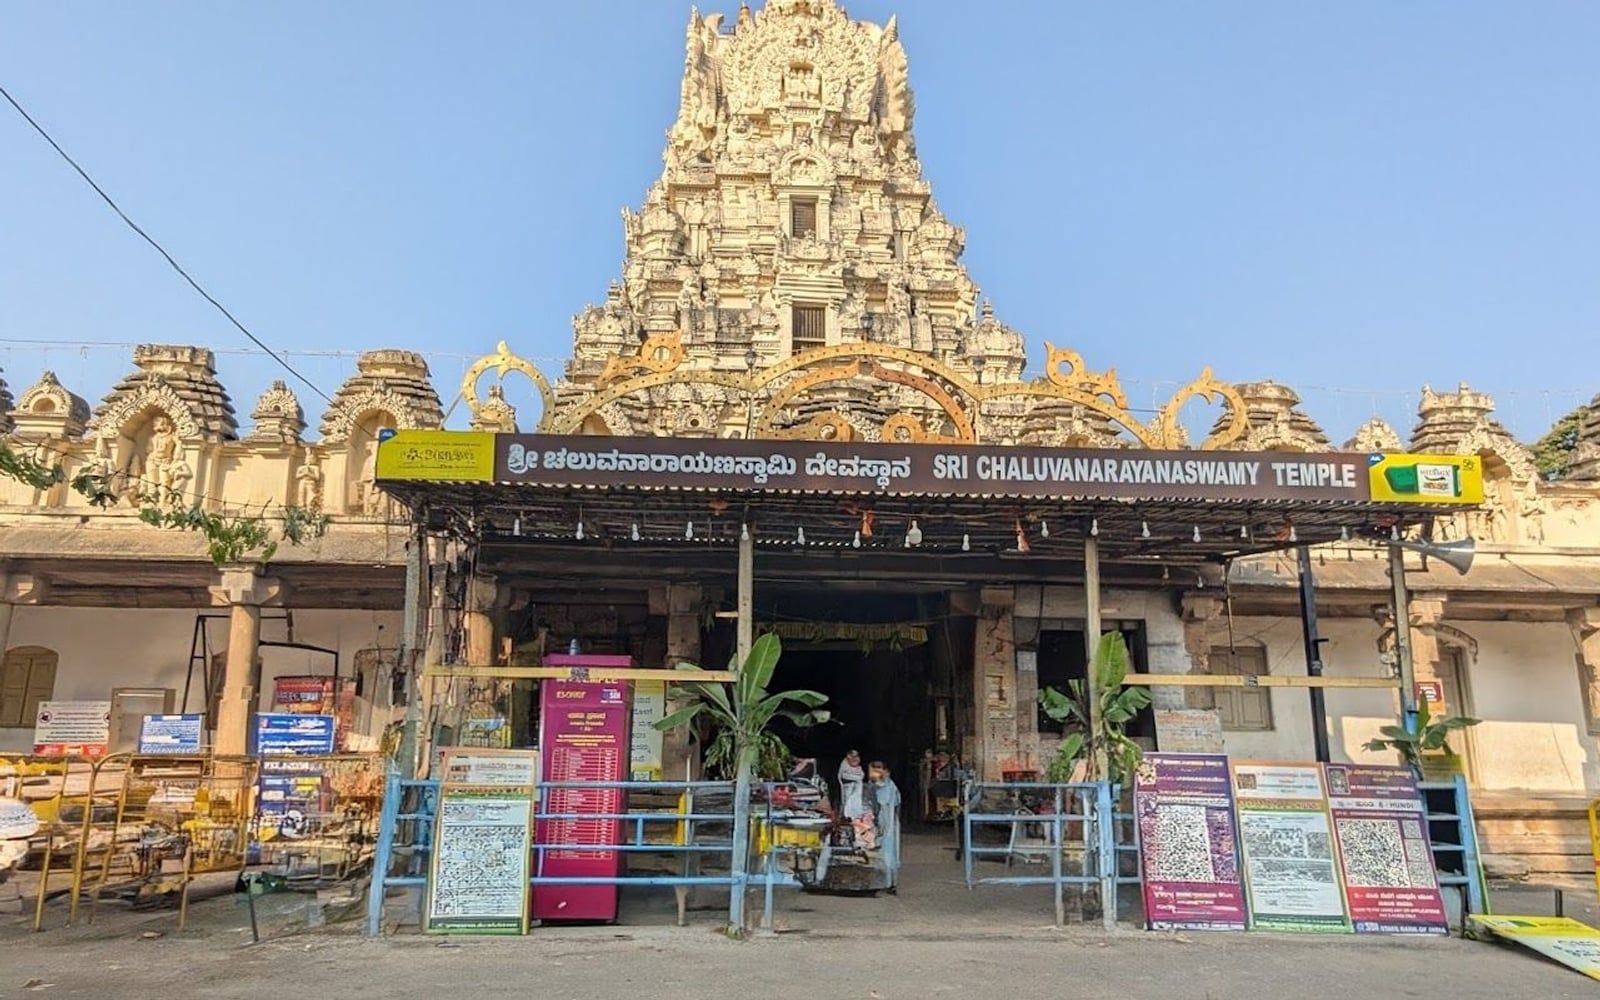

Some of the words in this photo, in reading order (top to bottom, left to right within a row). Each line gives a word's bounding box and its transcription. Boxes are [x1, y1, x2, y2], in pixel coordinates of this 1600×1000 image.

[507, 443, 539, 473] ಶ್ರೀ
[805, 452, 911, 487] ದೇವಸ್ಥಾನ
[933, 454, 969, 479] SRI
[976, 455, 1260, 485] CHALUVANARAYANASWAMY
[1272, 462, 1357, 487] TEMPLE
